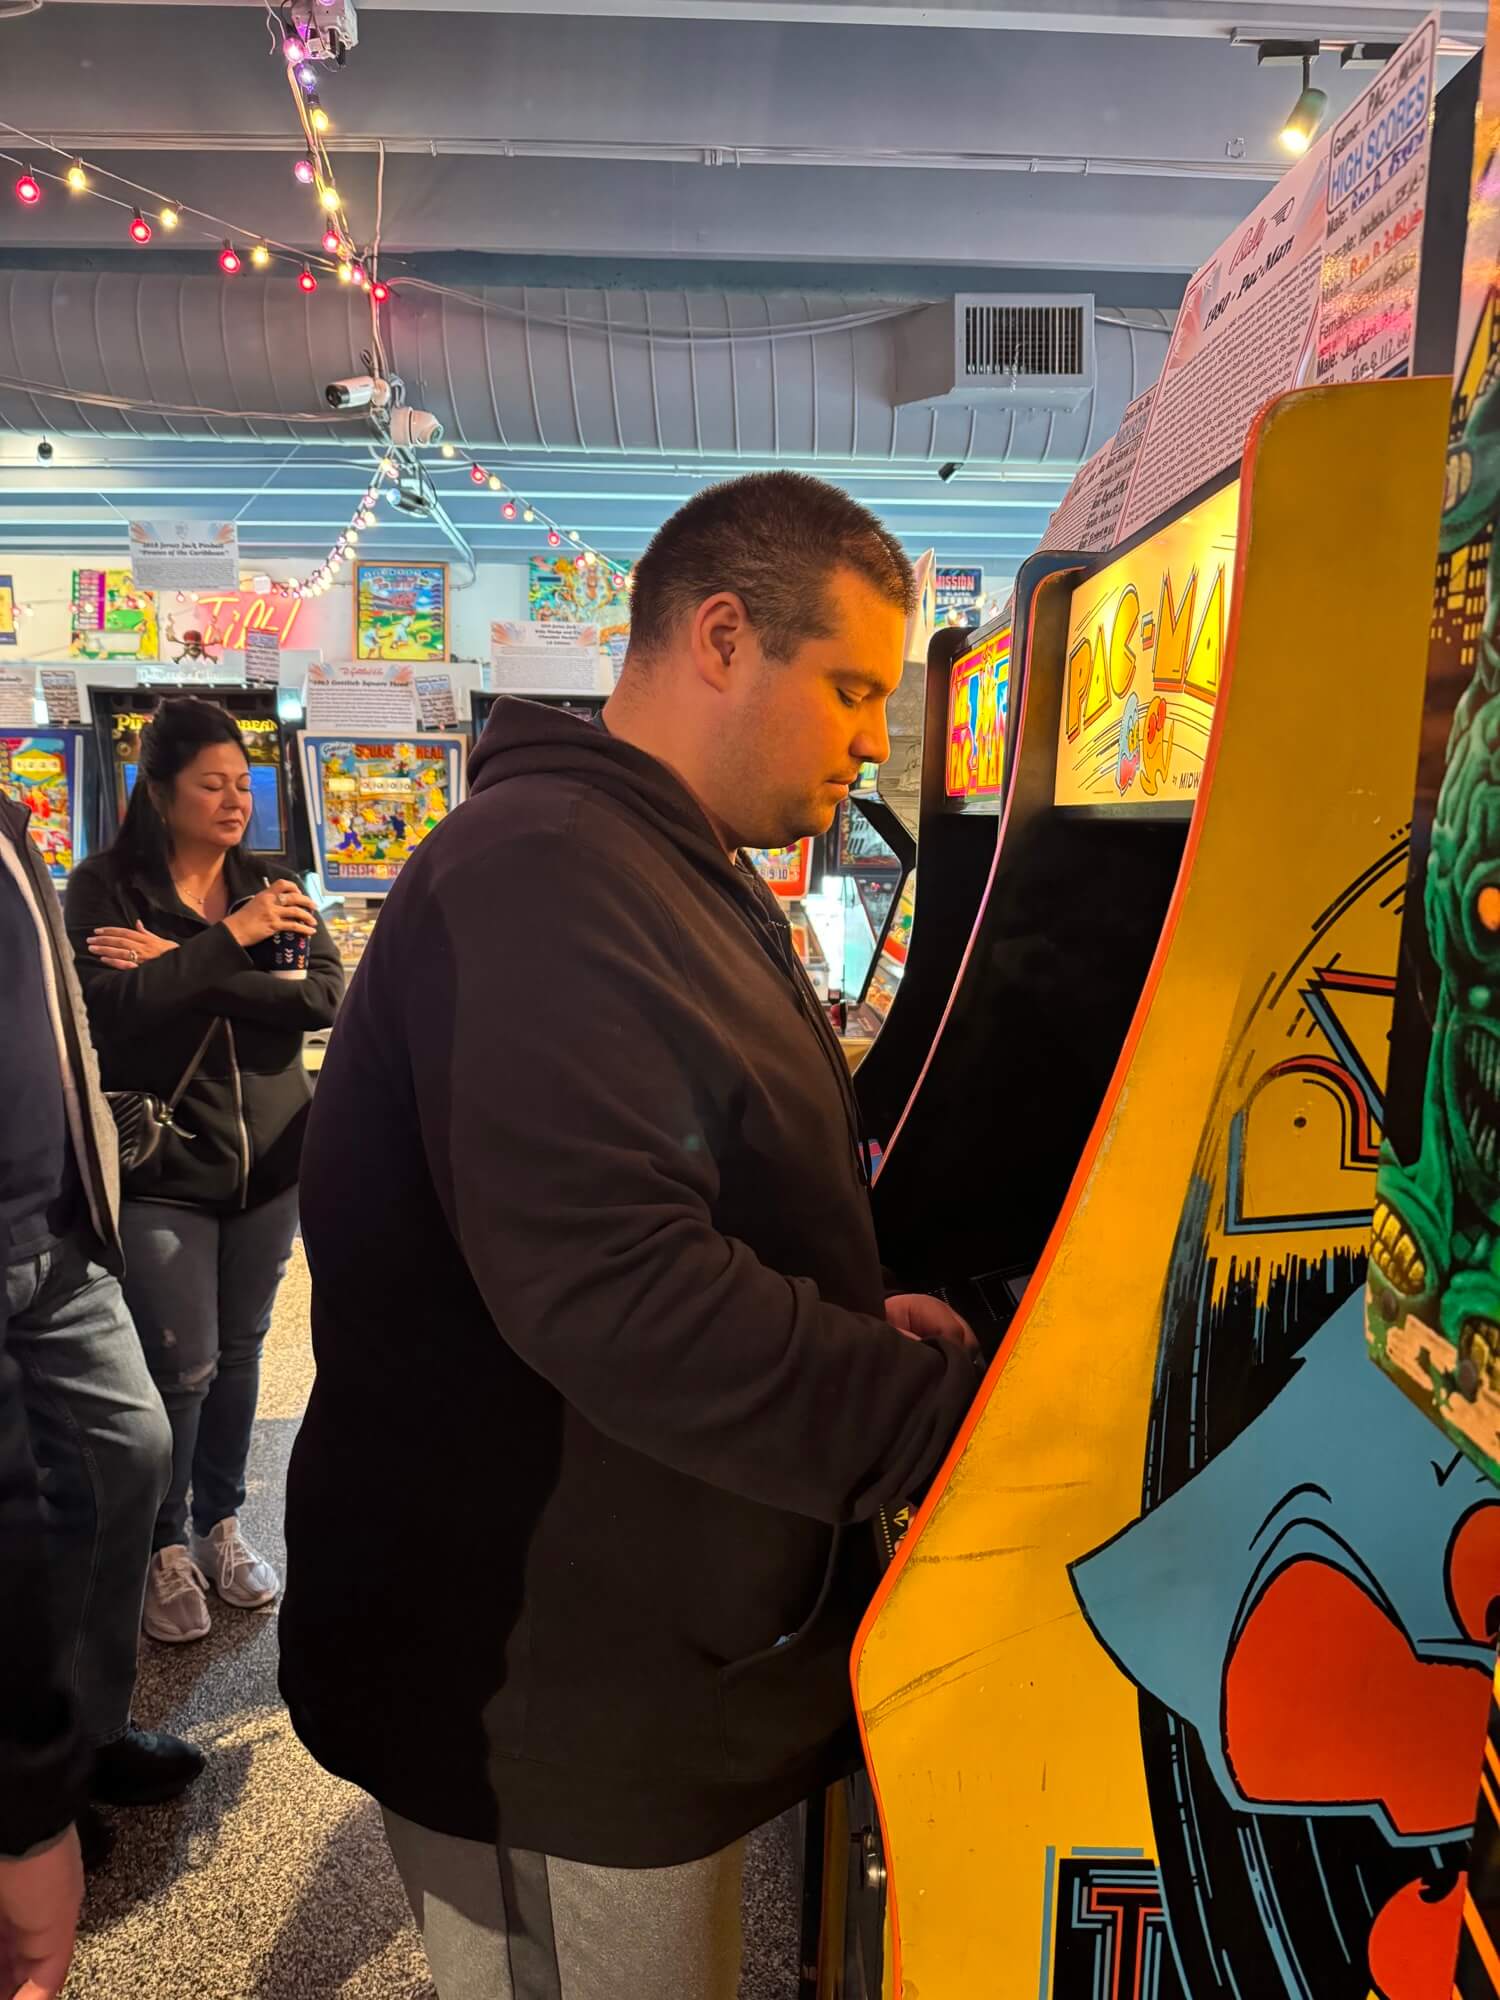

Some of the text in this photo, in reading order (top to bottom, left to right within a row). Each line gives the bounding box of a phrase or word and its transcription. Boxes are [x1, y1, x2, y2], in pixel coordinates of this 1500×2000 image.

[1331, 141, 1365, 207] HIGH
[1366, 75, 1426, 170] SCORES
[1333, 119, 1361, 158] Game:
[1327, 206, 1349, 240] Male:
[1203, 290, 1232, 332] 1980
[1236, 234, 1295, 301] Pac-Man
[1316, 351, 1339, 379] Male:
[1066, 562, 1226, 745] PAC-MA
[416, 745, 446, 760] HEAD
[1179, 771, 1201, 790] MIDW
